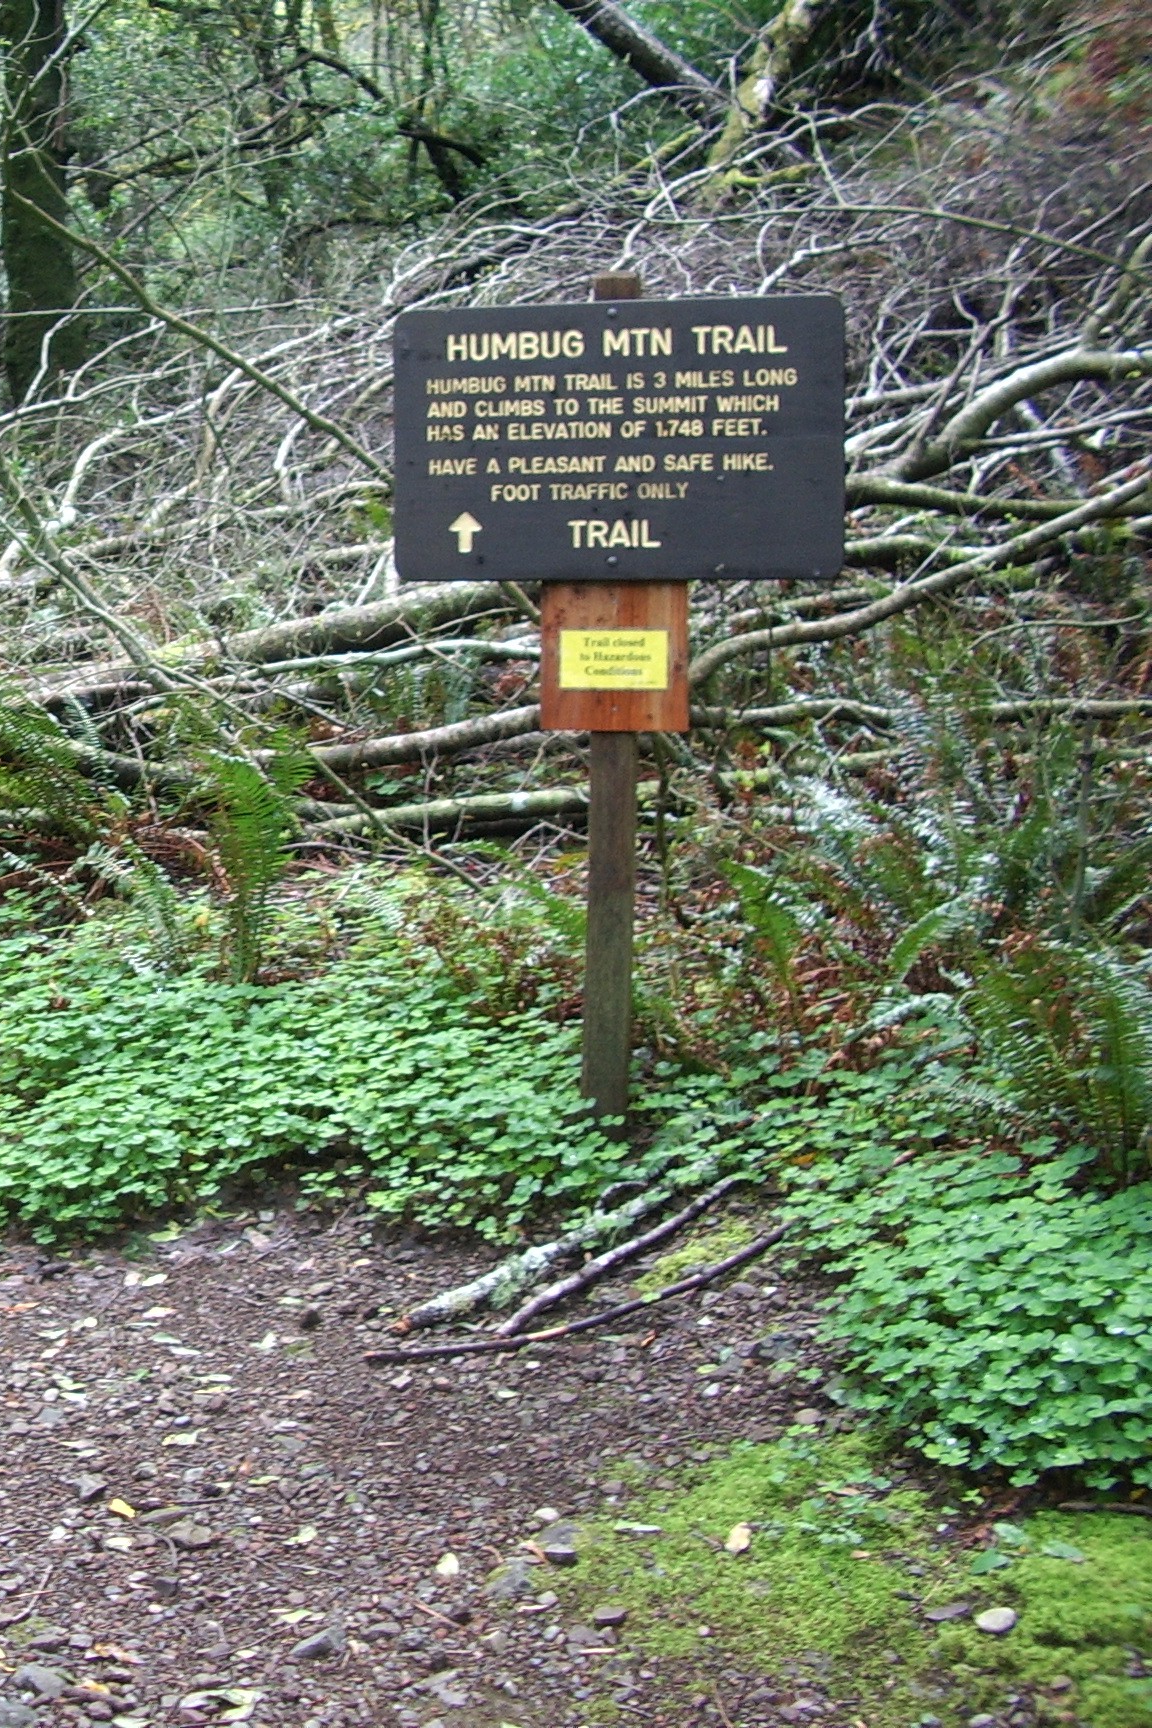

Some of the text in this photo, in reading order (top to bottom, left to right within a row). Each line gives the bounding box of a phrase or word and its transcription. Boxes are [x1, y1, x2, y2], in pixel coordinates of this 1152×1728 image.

[447, 325, 788, 362] HUMBUG MTN TRAIL
[427, 368, 797, 394] HUMBUG MTN TRAIL IS 3 MILES LONG
[427, 394, 779, 418] AND CLIMBS TO THE SUMMIT WHICH
[427, 424, 464, 441] HAS
[472, 424, 499, 440] AN
[508, 421, 611, 440] ELEVATION
[620, 420, 646, 438] OF
[712, 418, 767, 436] FEET.
[429, 453, 773, 475] HAVE A PLEASANT AND SAFE HIKE.
[491, 482, 688, 502] FOOT TRAFFIC ONLY
[568, 519, 661, 548] TRAIL
[583, 637, 610, 647] Trail
[579, 652, 590, 661] to
